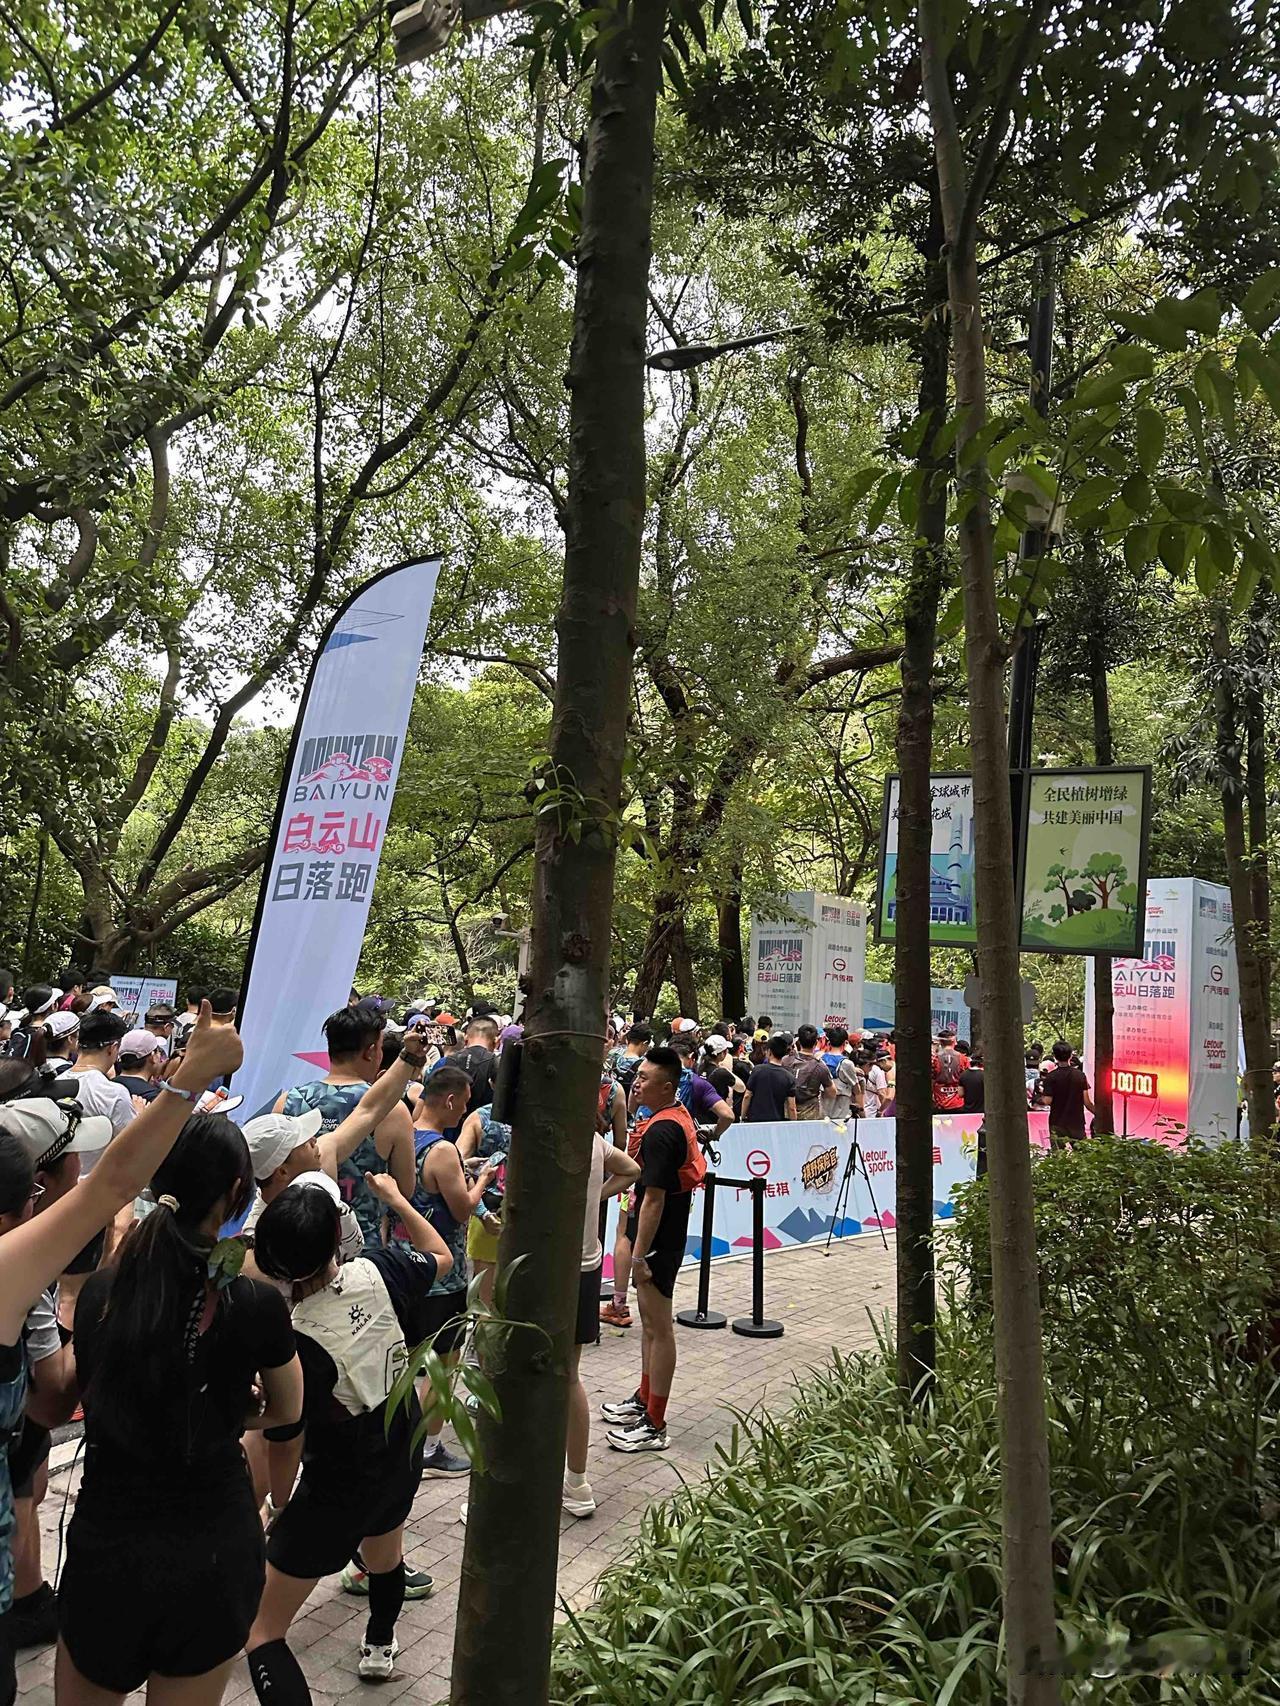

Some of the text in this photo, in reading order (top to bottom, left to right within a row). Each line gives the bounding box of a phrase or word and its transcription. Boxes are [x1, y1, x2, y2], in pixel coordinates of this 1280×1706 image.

[293, 783, 389, 803] BAIYUN
[1043, 785, 1128, 803] 全民植树增绿
[1042, 809, 1123, 826] 共建美丽中国
[282, 811, 382, 855] 白云山
[272, 861, 371, 904] 日落跑
[758, 963, 802, 971] BAIYUN
[758, 973, 801, 983] 白云山日落跑
[1115, 971, 1176, 982] AIYUN
[1113, 983, 1175, 998] 云山日落跑
[824, 1014, 847, 1023] Letour
[1203, 1039, 1224, 1049] Letour
[1207, 1049, 1227, 1060] sports
[862, 1150, 887, 1161] Letour
[869, 1159, 893, 1176] sports
[736, 1182, 790, 1202] 广传祺
[351, 1313, 372, 1336] KAILAS
